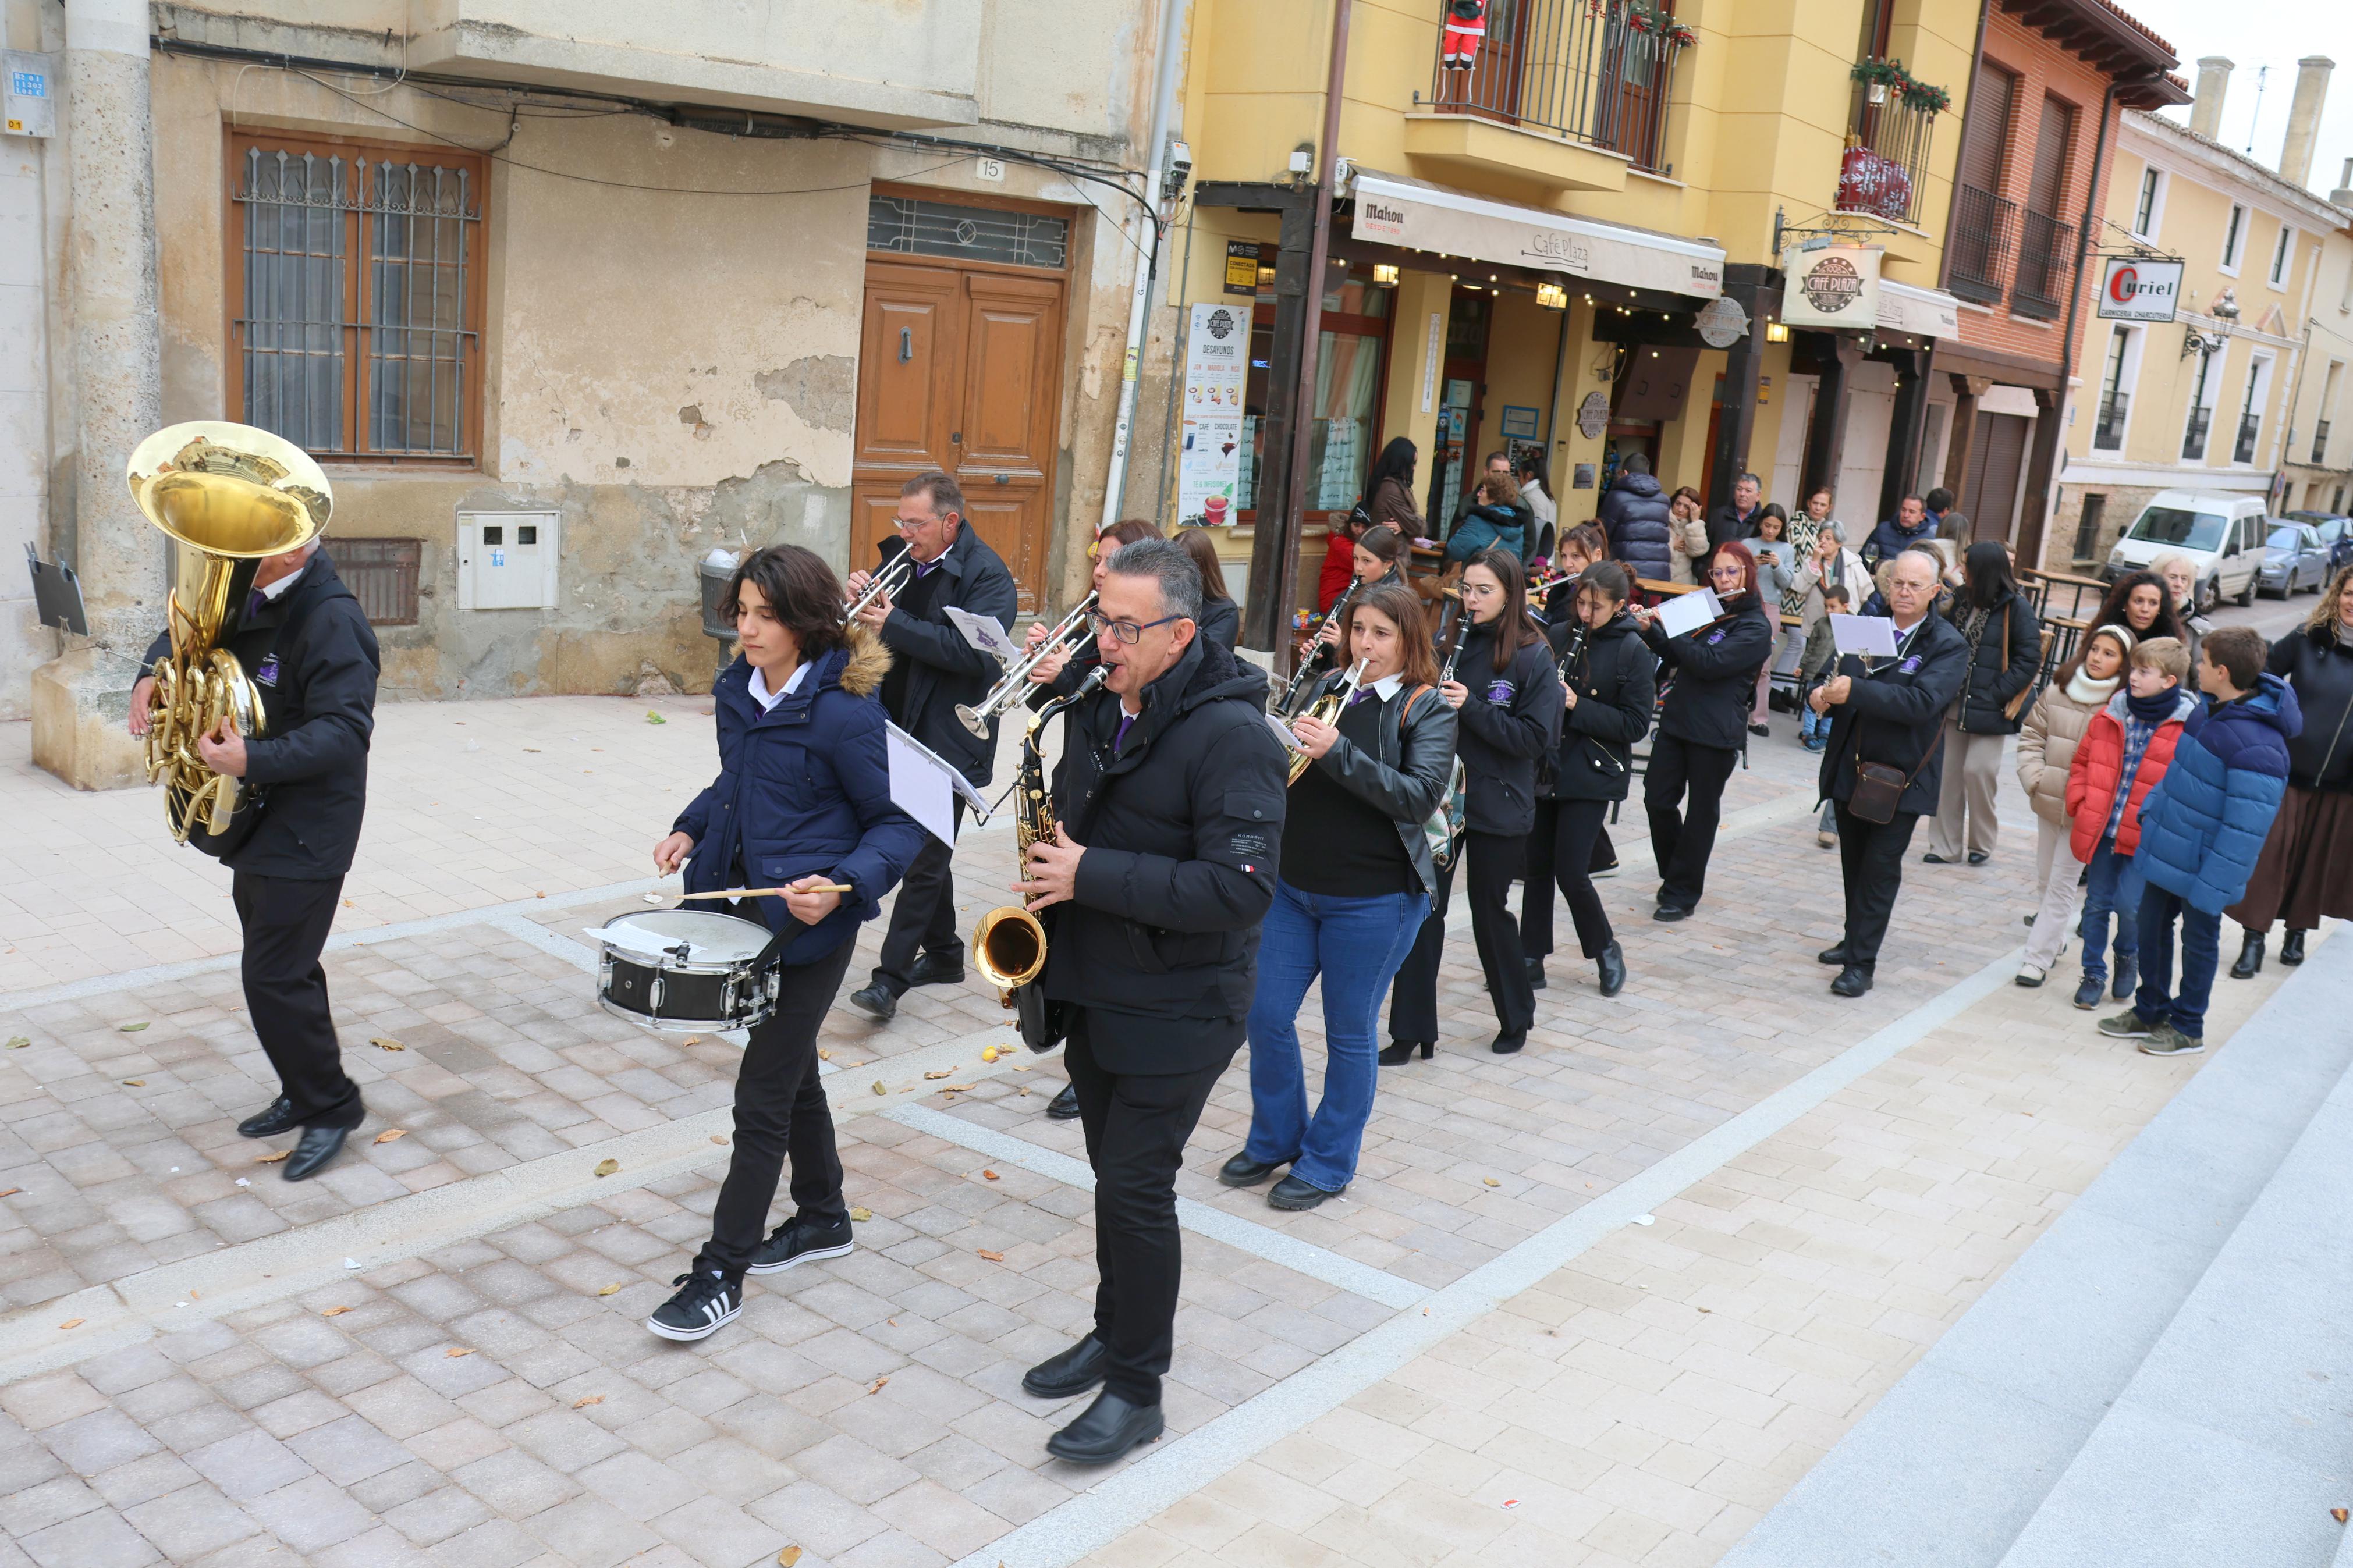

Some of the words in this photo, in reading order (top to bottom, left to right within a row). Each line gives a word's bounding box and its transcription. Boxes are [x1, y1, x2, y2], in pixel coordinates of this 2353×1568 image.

[982, 161, 998, 177] 15
[1365, 203, 1404, 223] Mahou
[1533, 233, 1561, 255] Café
[1562, 237, 1588, 263] Plaza
[1692, 265, 1718, 282] Mahou
[1807, 275, 1829, 291] CAFÉ
[1830, 278, 1857, 291] PLAZA
[2110, 267, 2173, 302] Curiel
[1202, 344, 1234, 355] DESAYUNOS
[1199, 422, 1209, 431] CAFÉ
